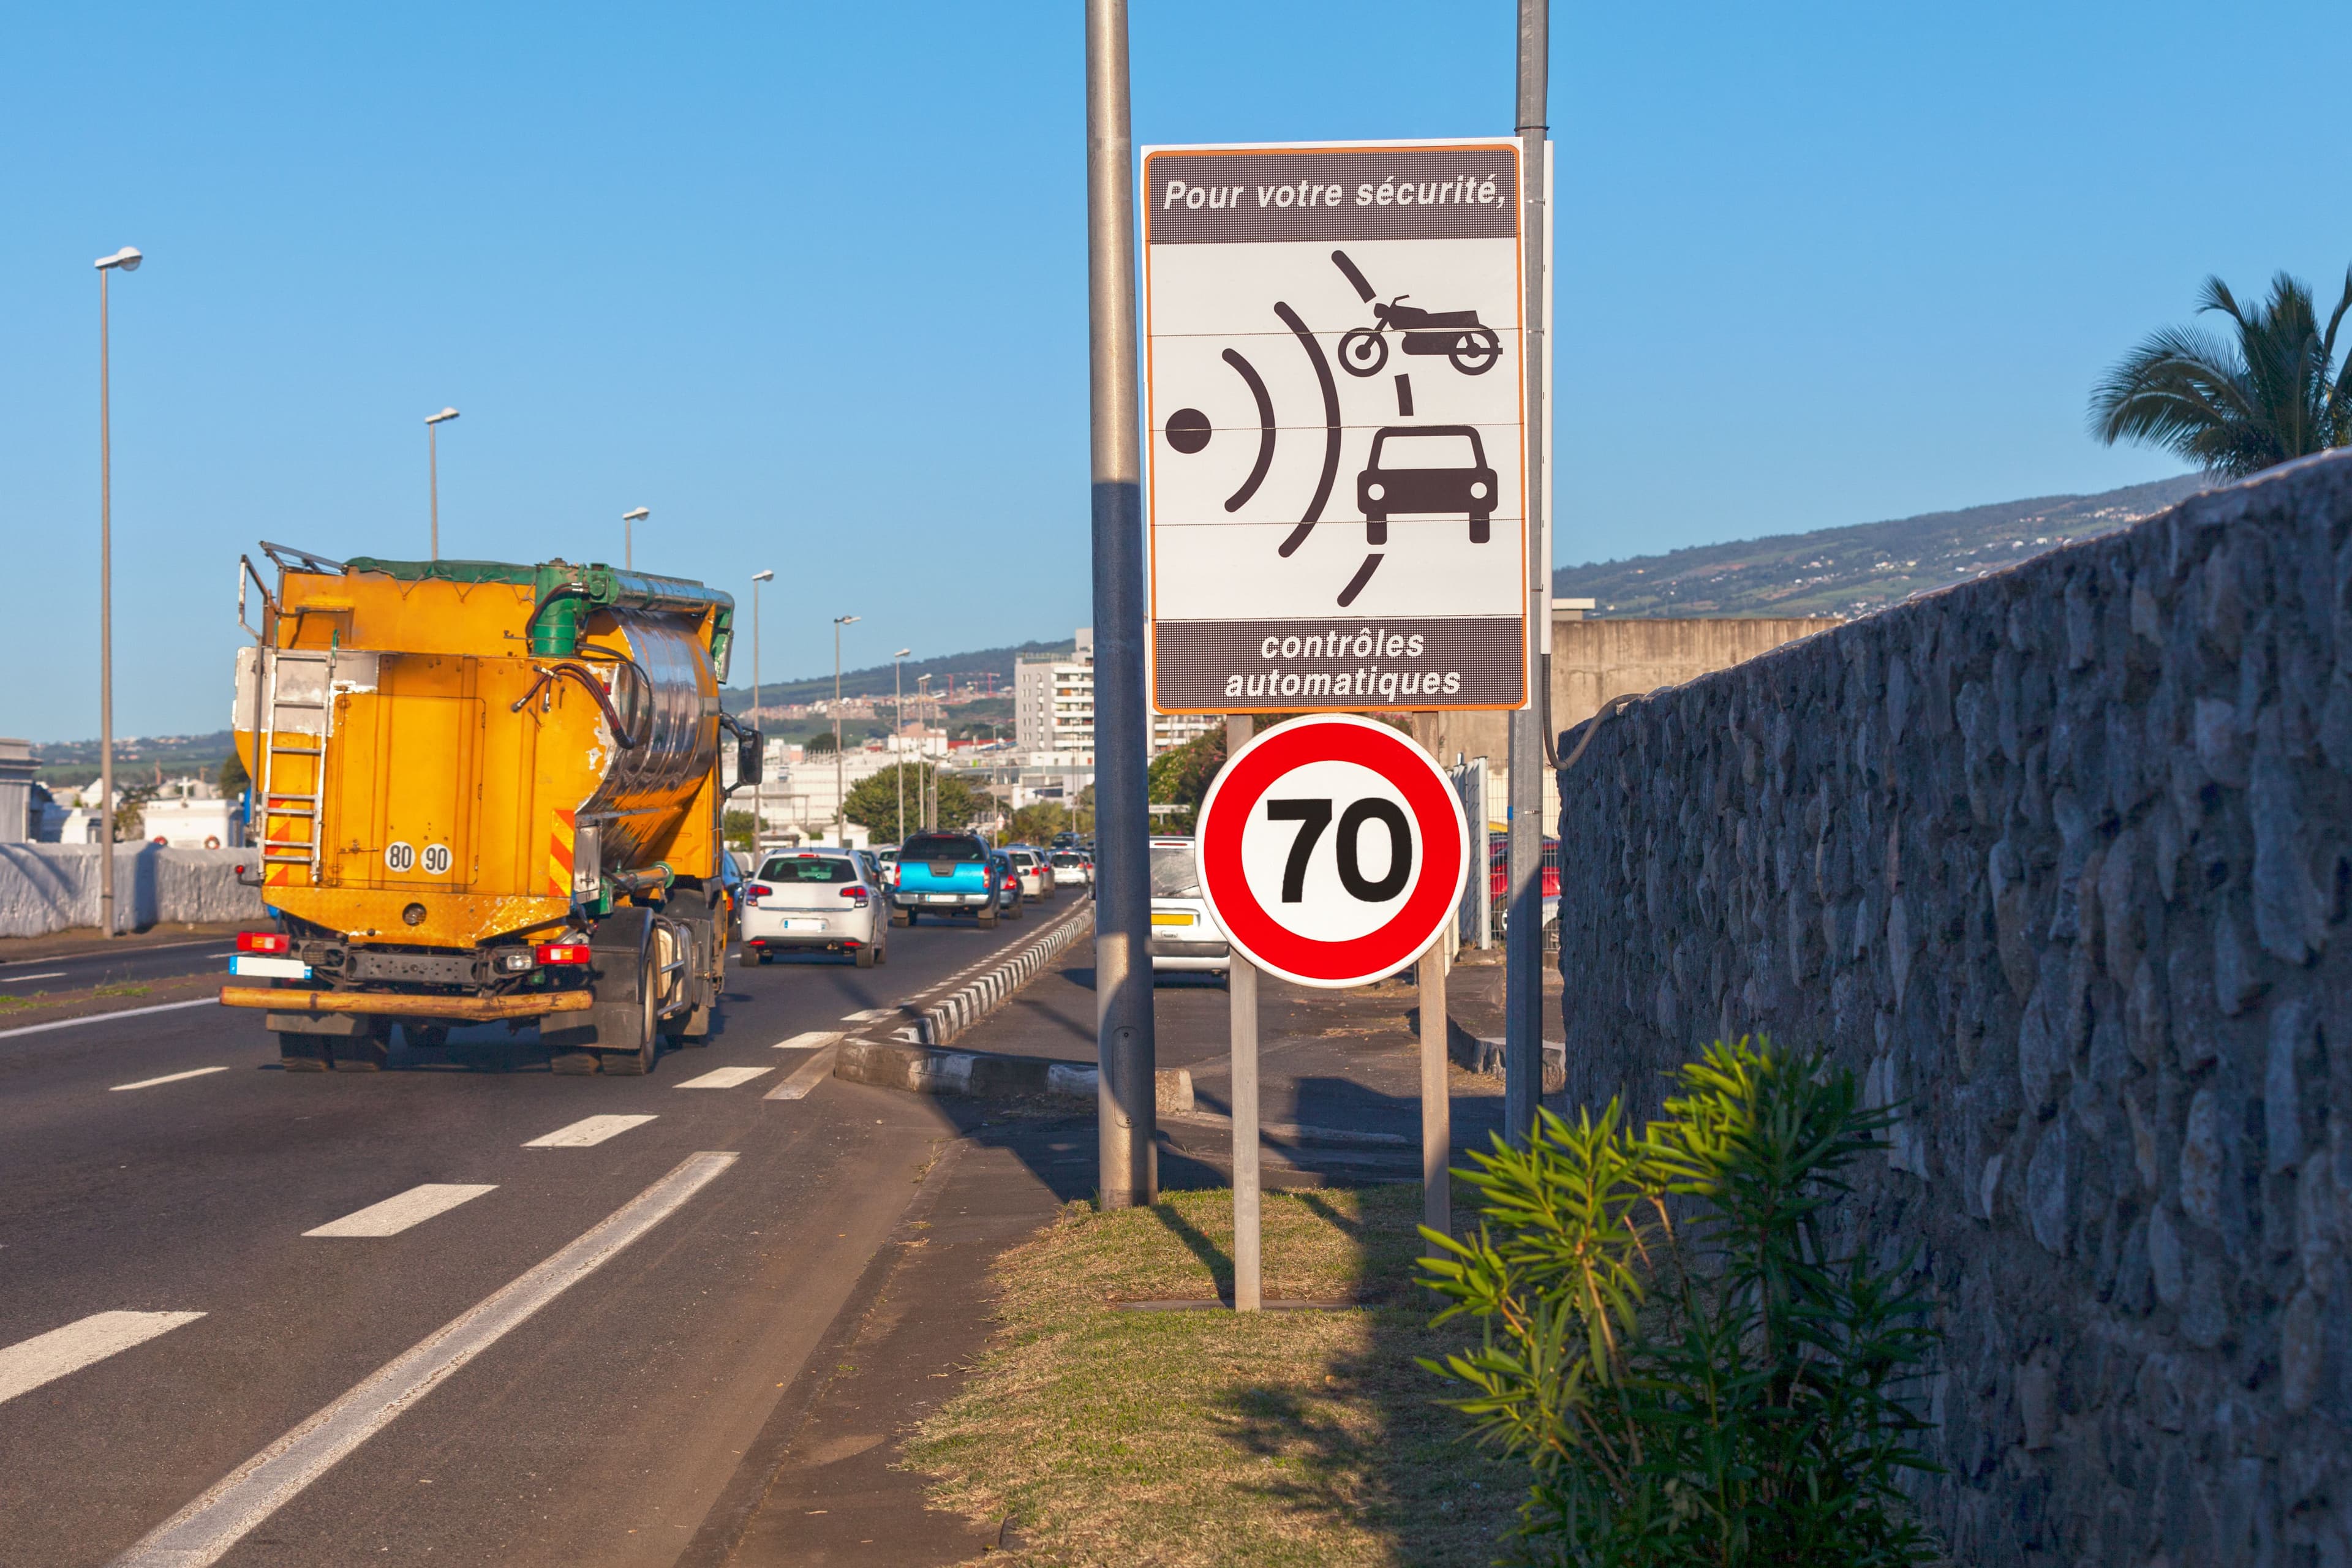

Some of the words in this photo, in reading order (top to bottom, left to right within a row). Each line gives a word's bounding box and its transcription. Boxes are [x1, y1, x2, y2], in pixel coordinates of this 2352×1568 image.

[1164, 181, 1243, 209] Pour
[1257, 180, 1343, 208] votre
[1356, 174, 1506, 208] sécurité,
[1261, 628, 1425, 659] contrôles
[1225, 666, 1460, 702] automatiques
[390, 845, 412, 869] 80
[426, 847, 448, 871] 90
[1267, 797, 1412, 903] 70
